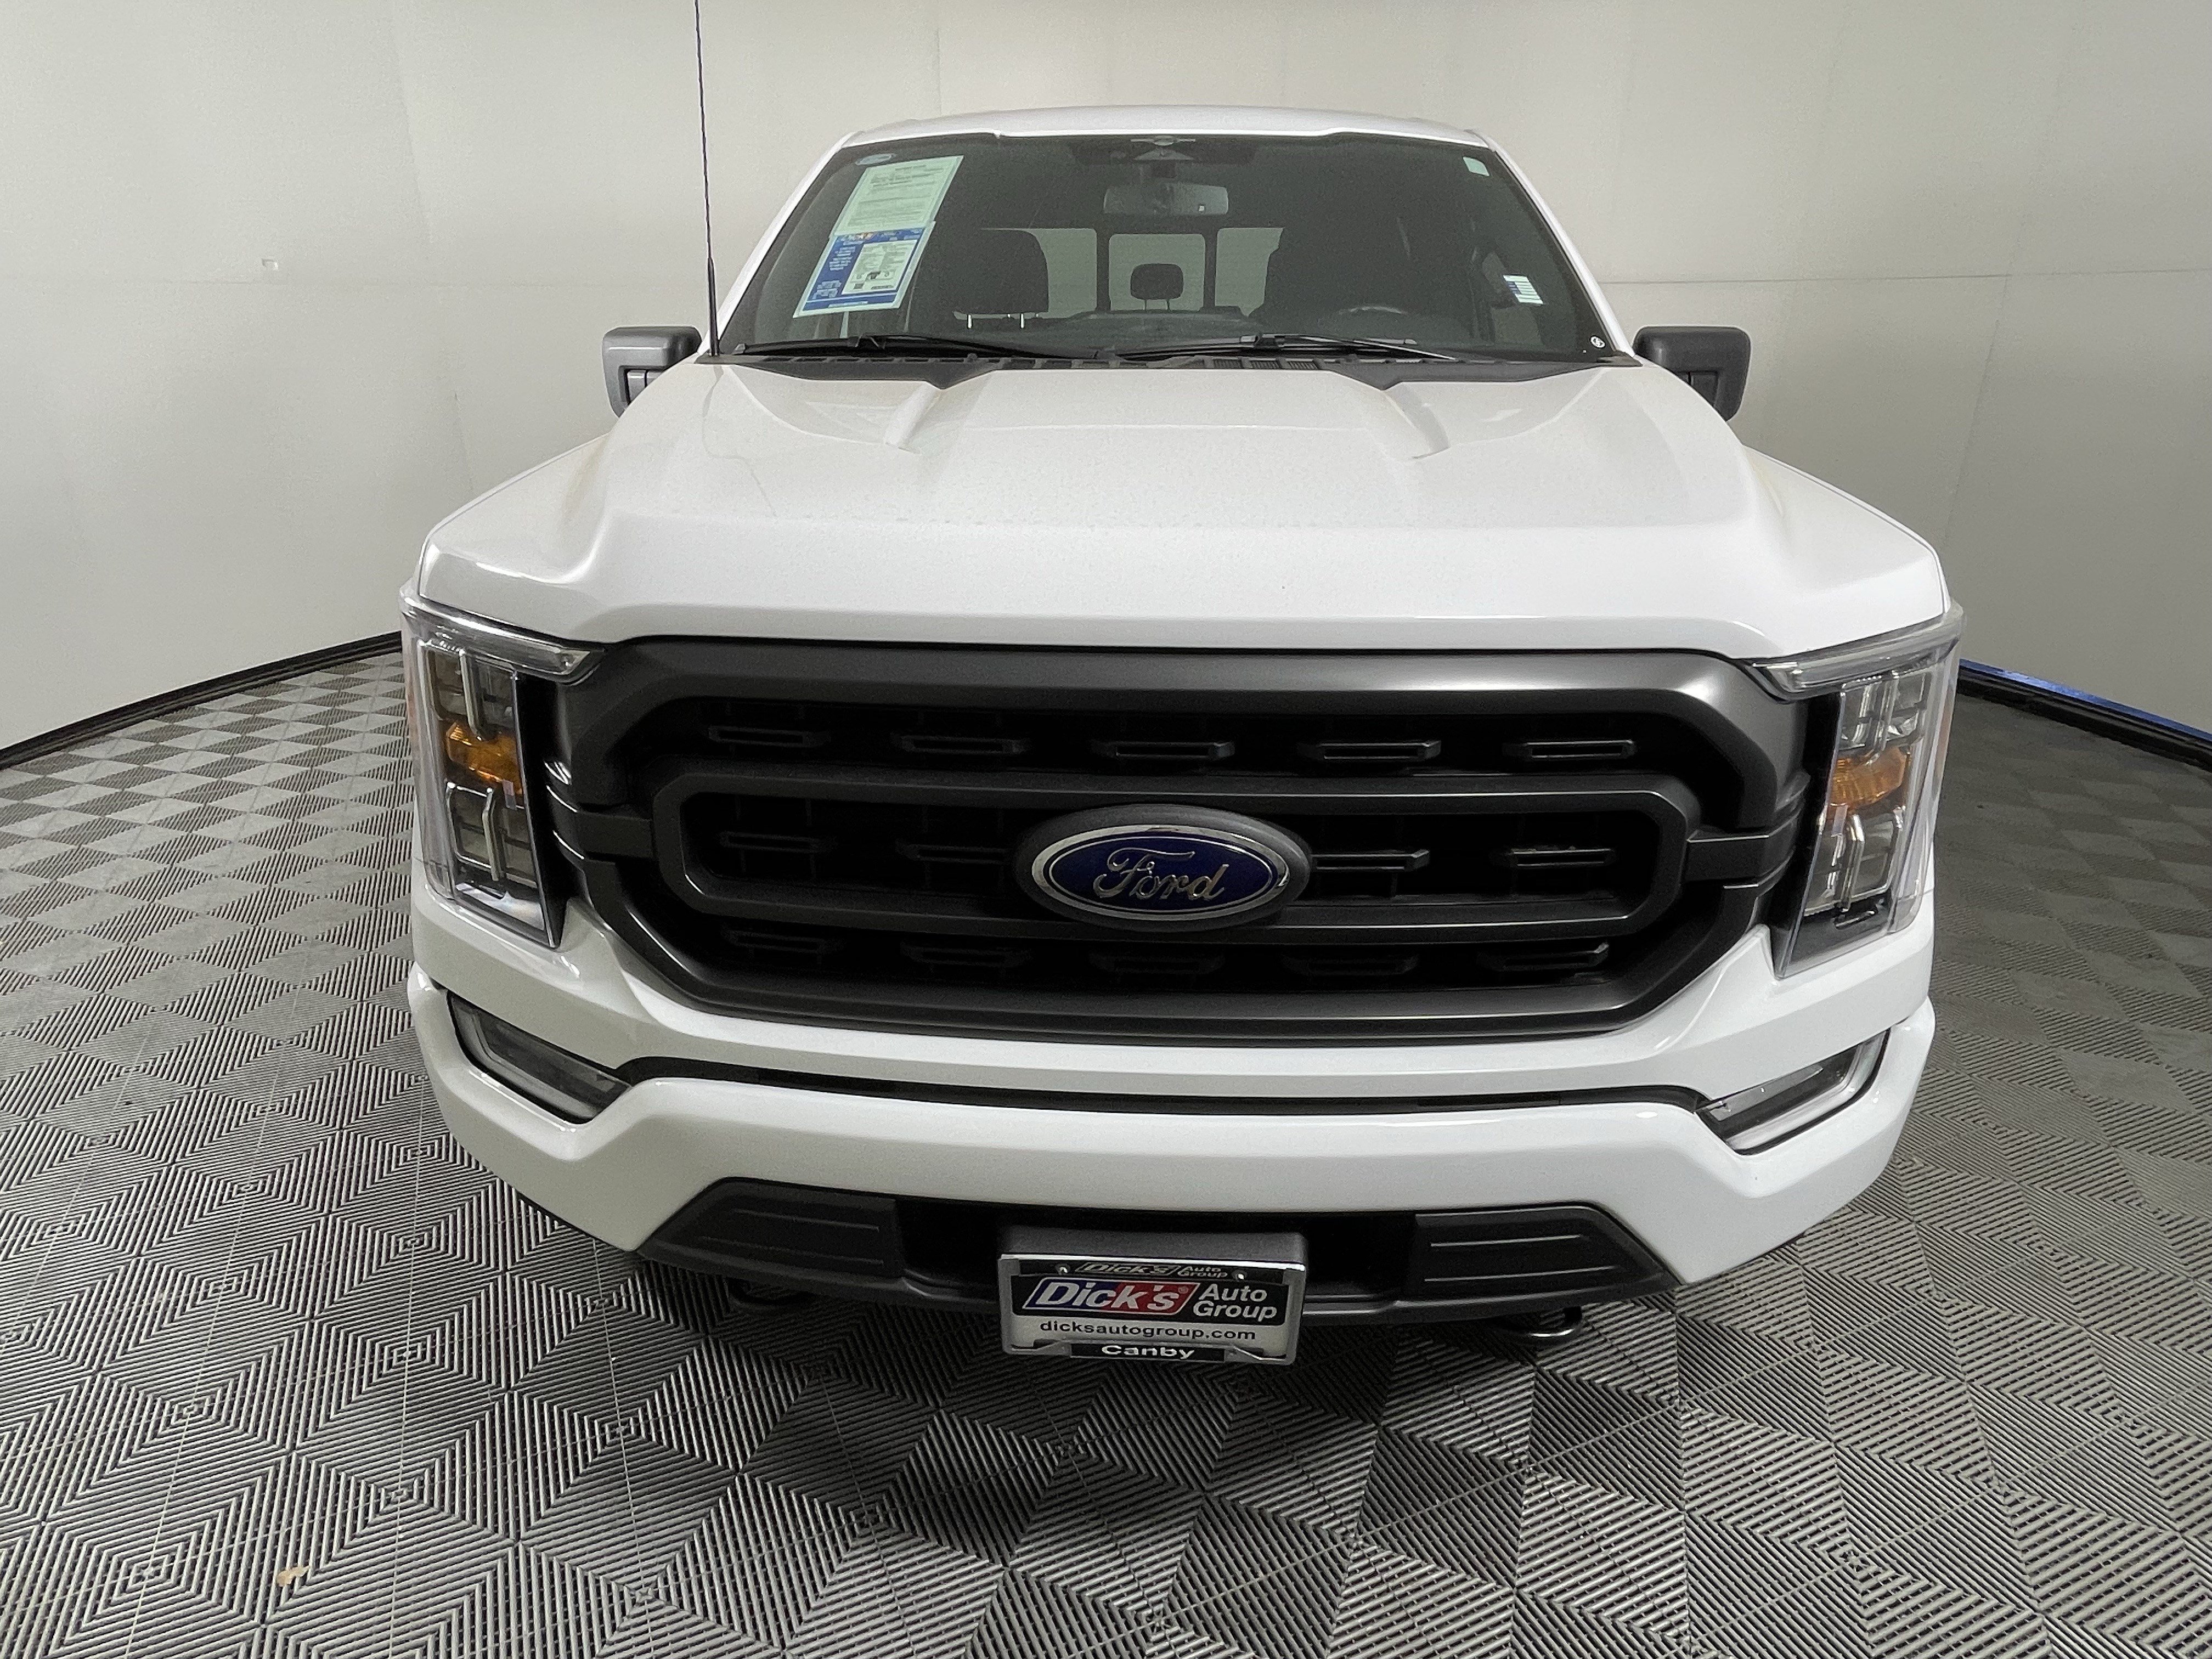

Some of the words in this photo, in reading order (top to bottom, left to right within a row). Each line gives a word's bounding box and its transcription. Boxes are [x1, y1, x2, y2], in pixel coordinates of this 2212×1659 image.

[1093, 847, 1229, 900] Ford
[1083, 1263, 1170, 1273] Dick's
[1035, 1281, 1175, 1311] Dick's
[1199, 1284, 1267, 1303] Auto
[1193, 1301, 1277, 1322] Group
[1040, 1321, 1256, 1340] dicksautogroup.com
[1101, 1345, 1195, 1359] Canby
